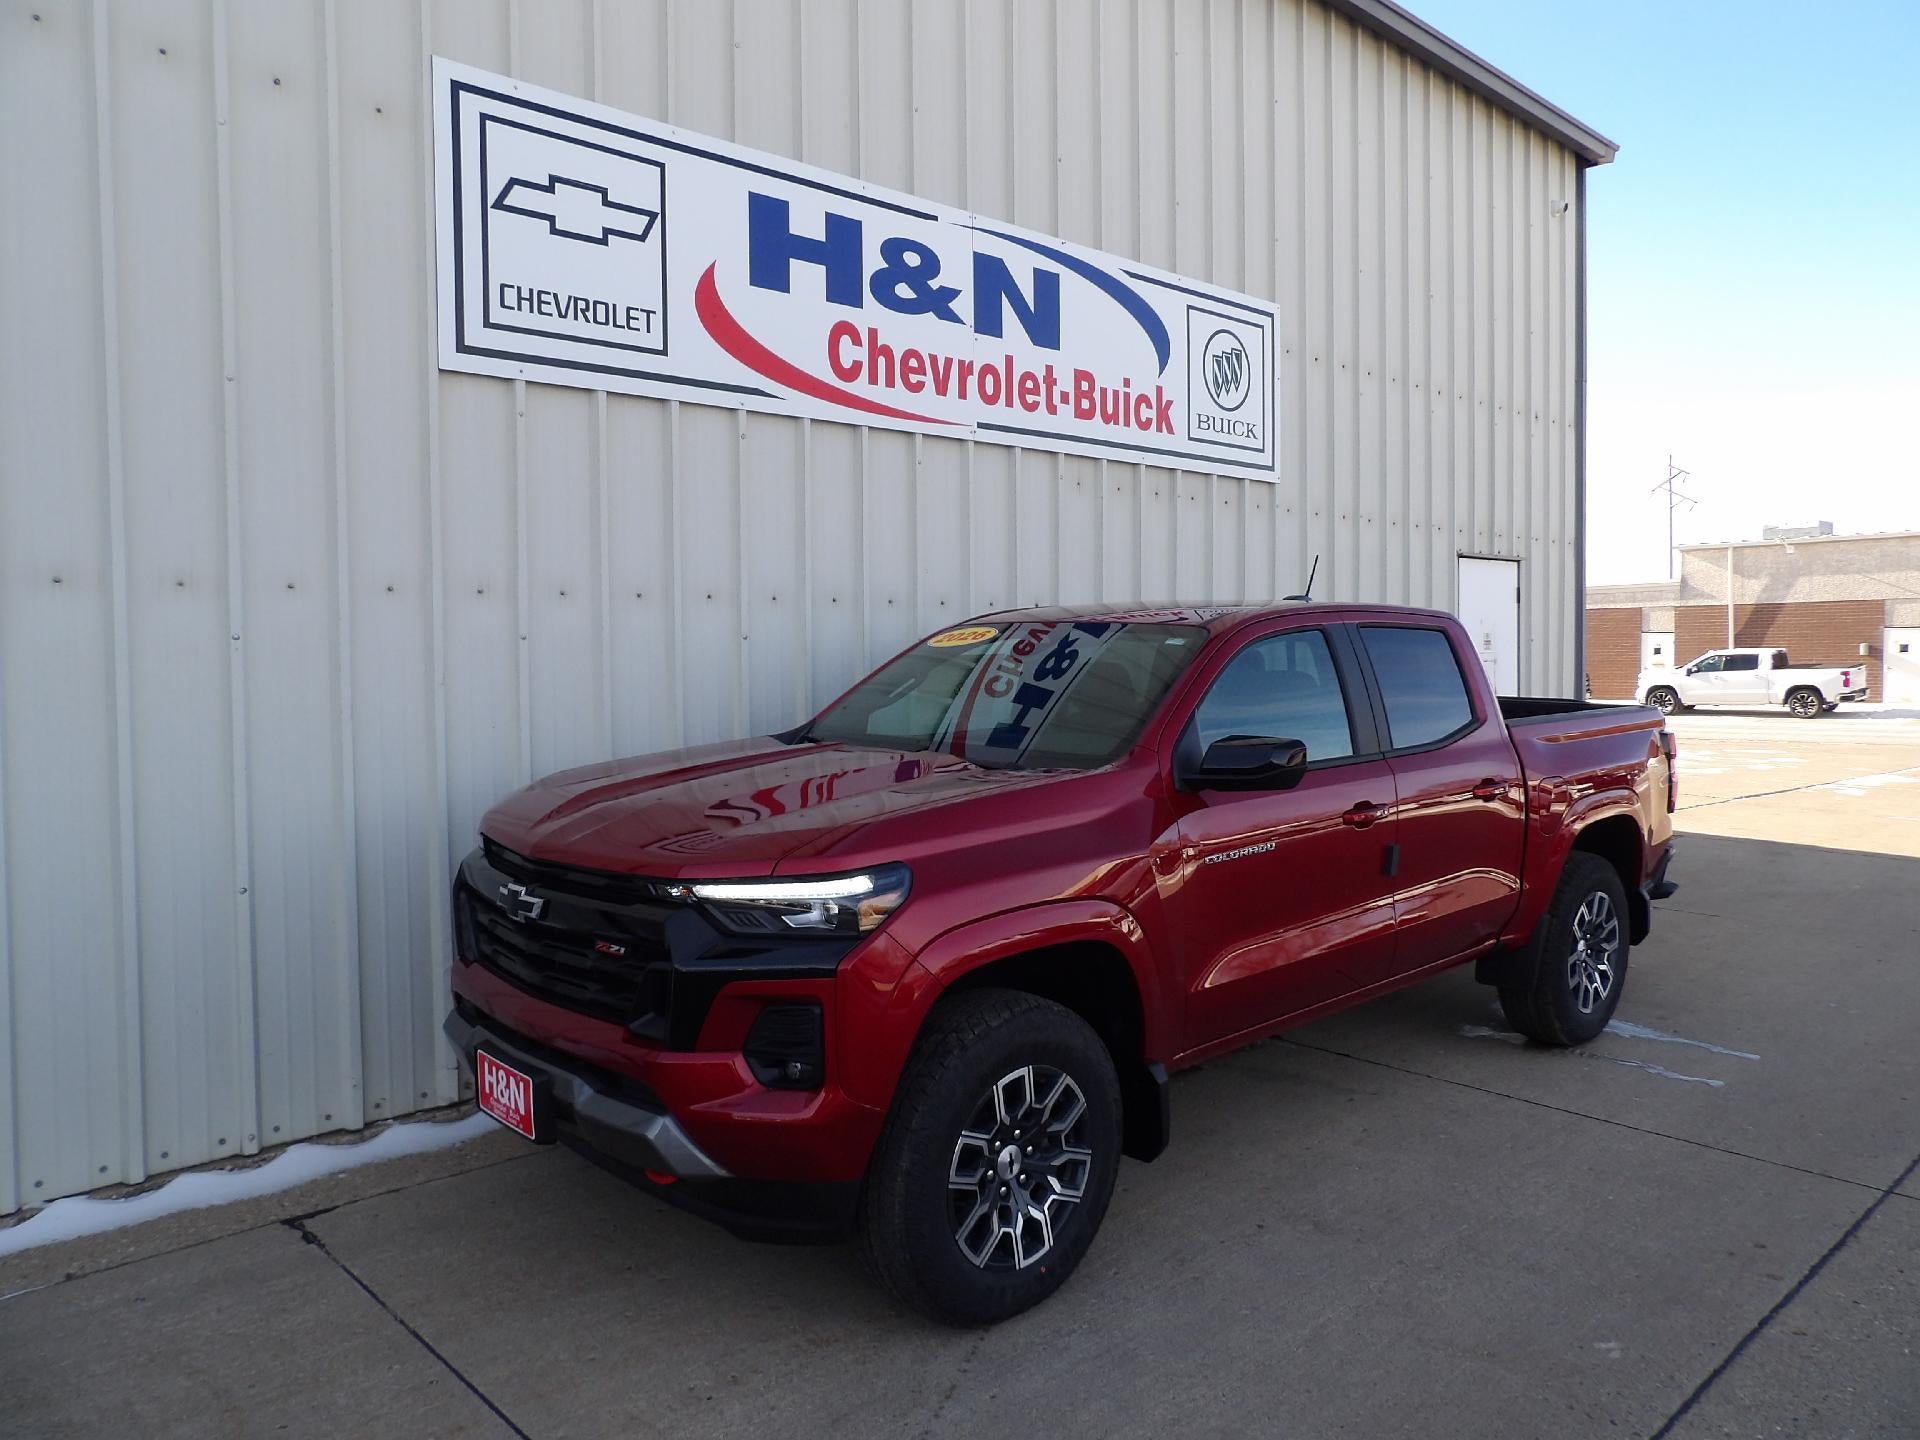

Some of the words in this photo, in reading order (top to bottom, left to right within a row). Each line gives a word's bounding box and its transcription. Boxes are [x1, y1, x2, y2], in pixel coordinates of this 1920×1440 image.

[748, 191, 1061, 352] H&N
[499, 283, 657, 334] CHEVROLET
[827, 320, 1176, 436] Chevrolet-Buick
[1195, 413, 1259, 440] BUICK
[1204, 842, 1276, 864] COLORADO
[484, 1060, 525, 1116] H&N
